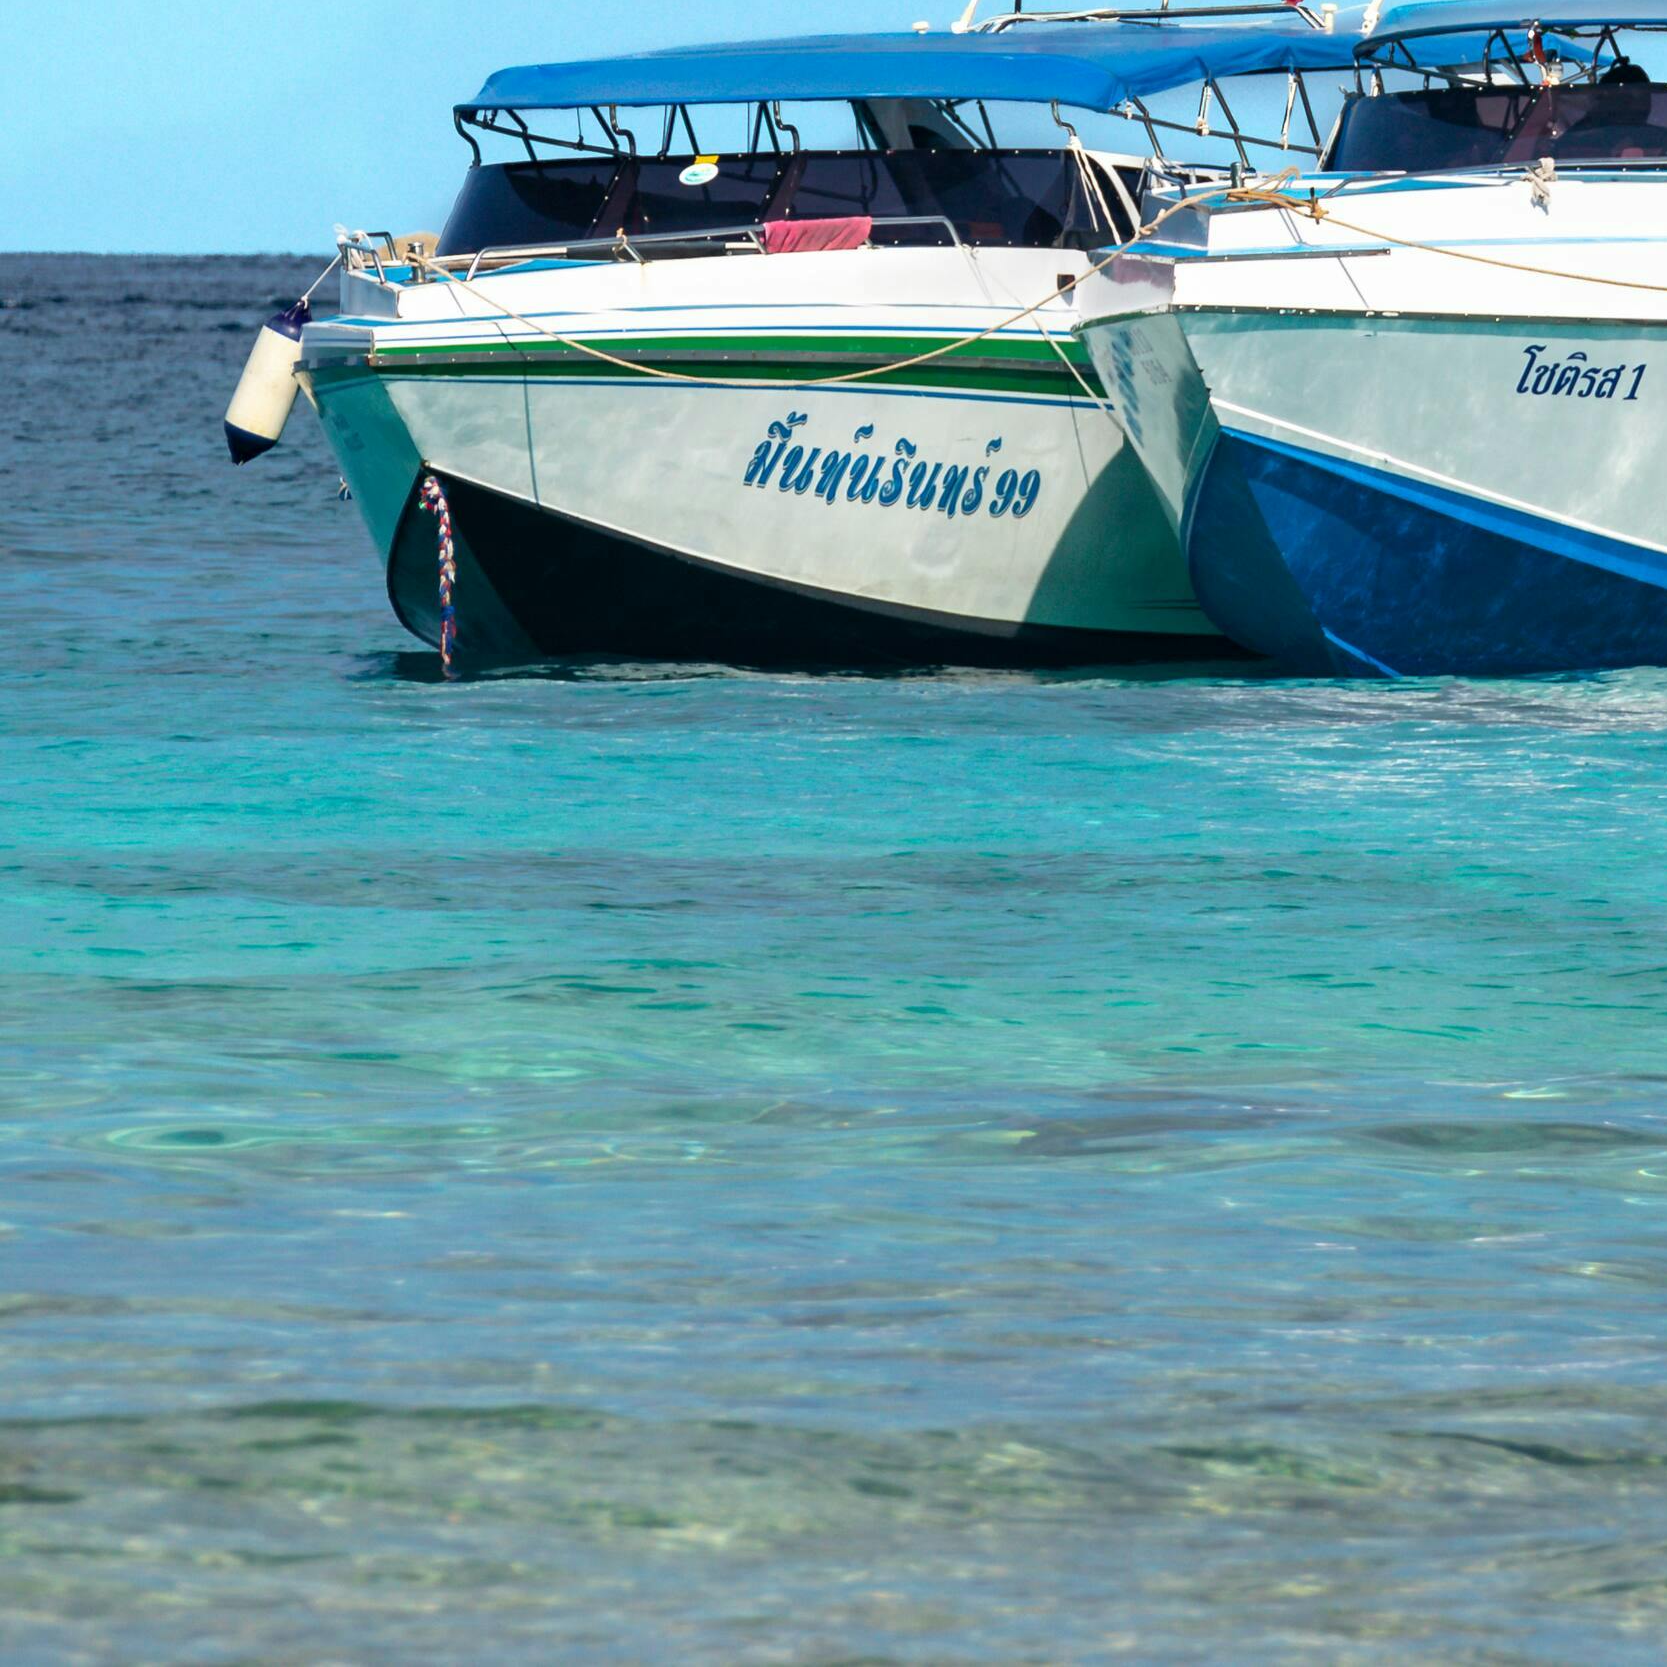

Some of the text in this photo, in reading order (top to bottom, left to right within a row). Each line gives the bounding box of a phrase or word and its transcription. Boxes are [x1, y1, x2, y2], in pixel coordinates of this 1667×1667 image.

[1516, 345, 1647, 400] โชติรส 1
[989, 468, 1041, 519] 99
